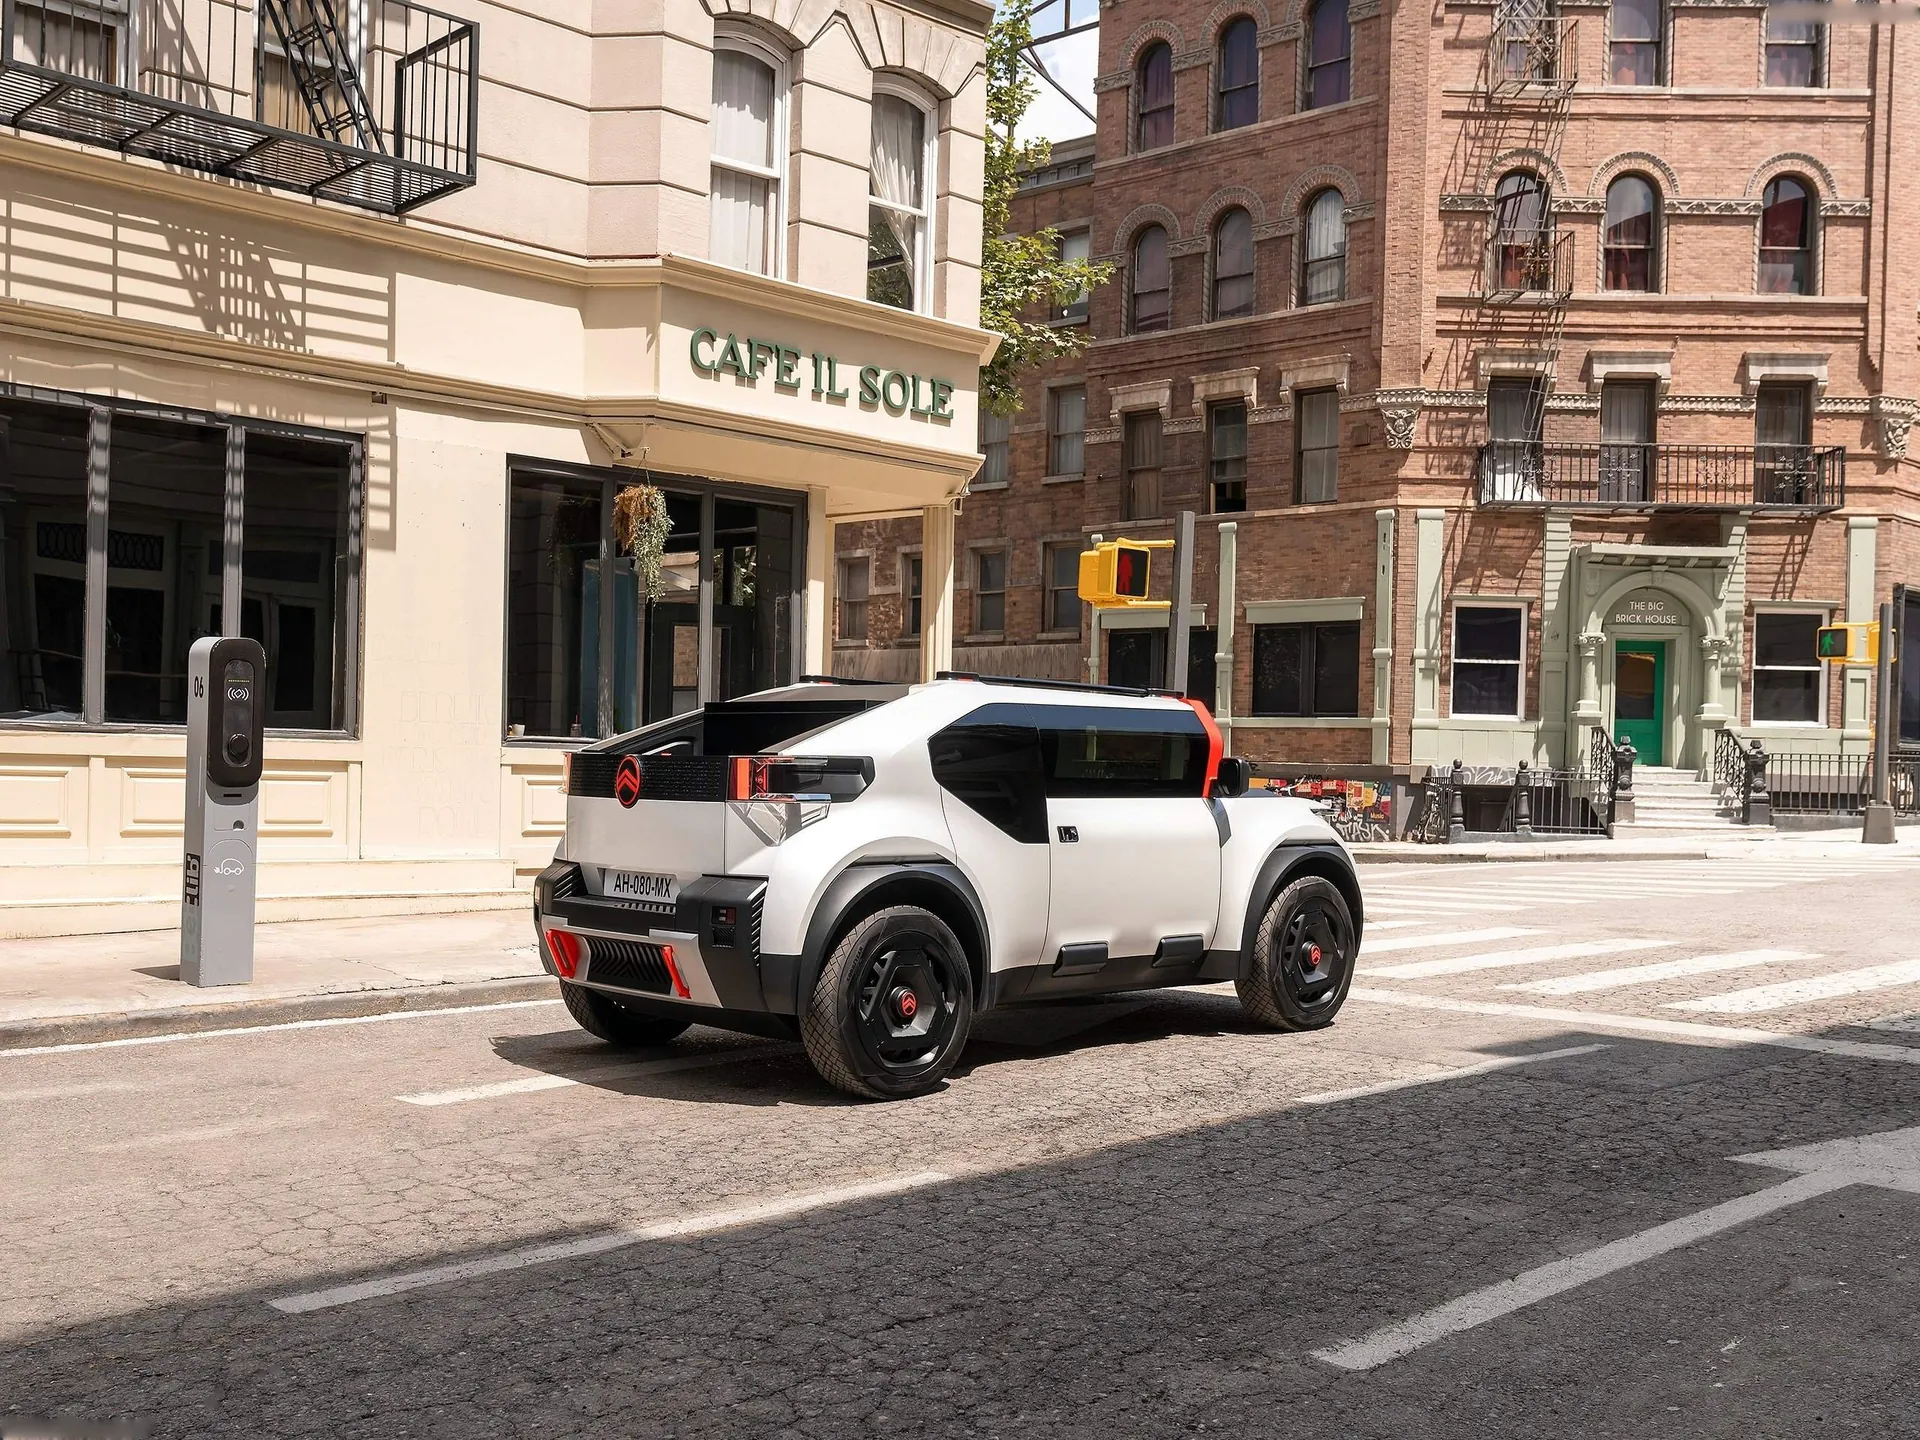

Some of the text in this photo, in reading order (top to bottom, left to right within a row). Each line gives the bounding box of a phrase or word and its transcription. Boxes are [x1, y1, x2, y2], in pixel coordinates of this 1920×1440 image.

[689, 326, 955, 420] CAFE IL SOLE
[1629, 601, 1665, 611] THE BIG
[1615, 614, 1677, 624] BRICK HOUSE
[194, 676, 204, 699] 06
[613, 873, 672, 898] AH-080-MX
